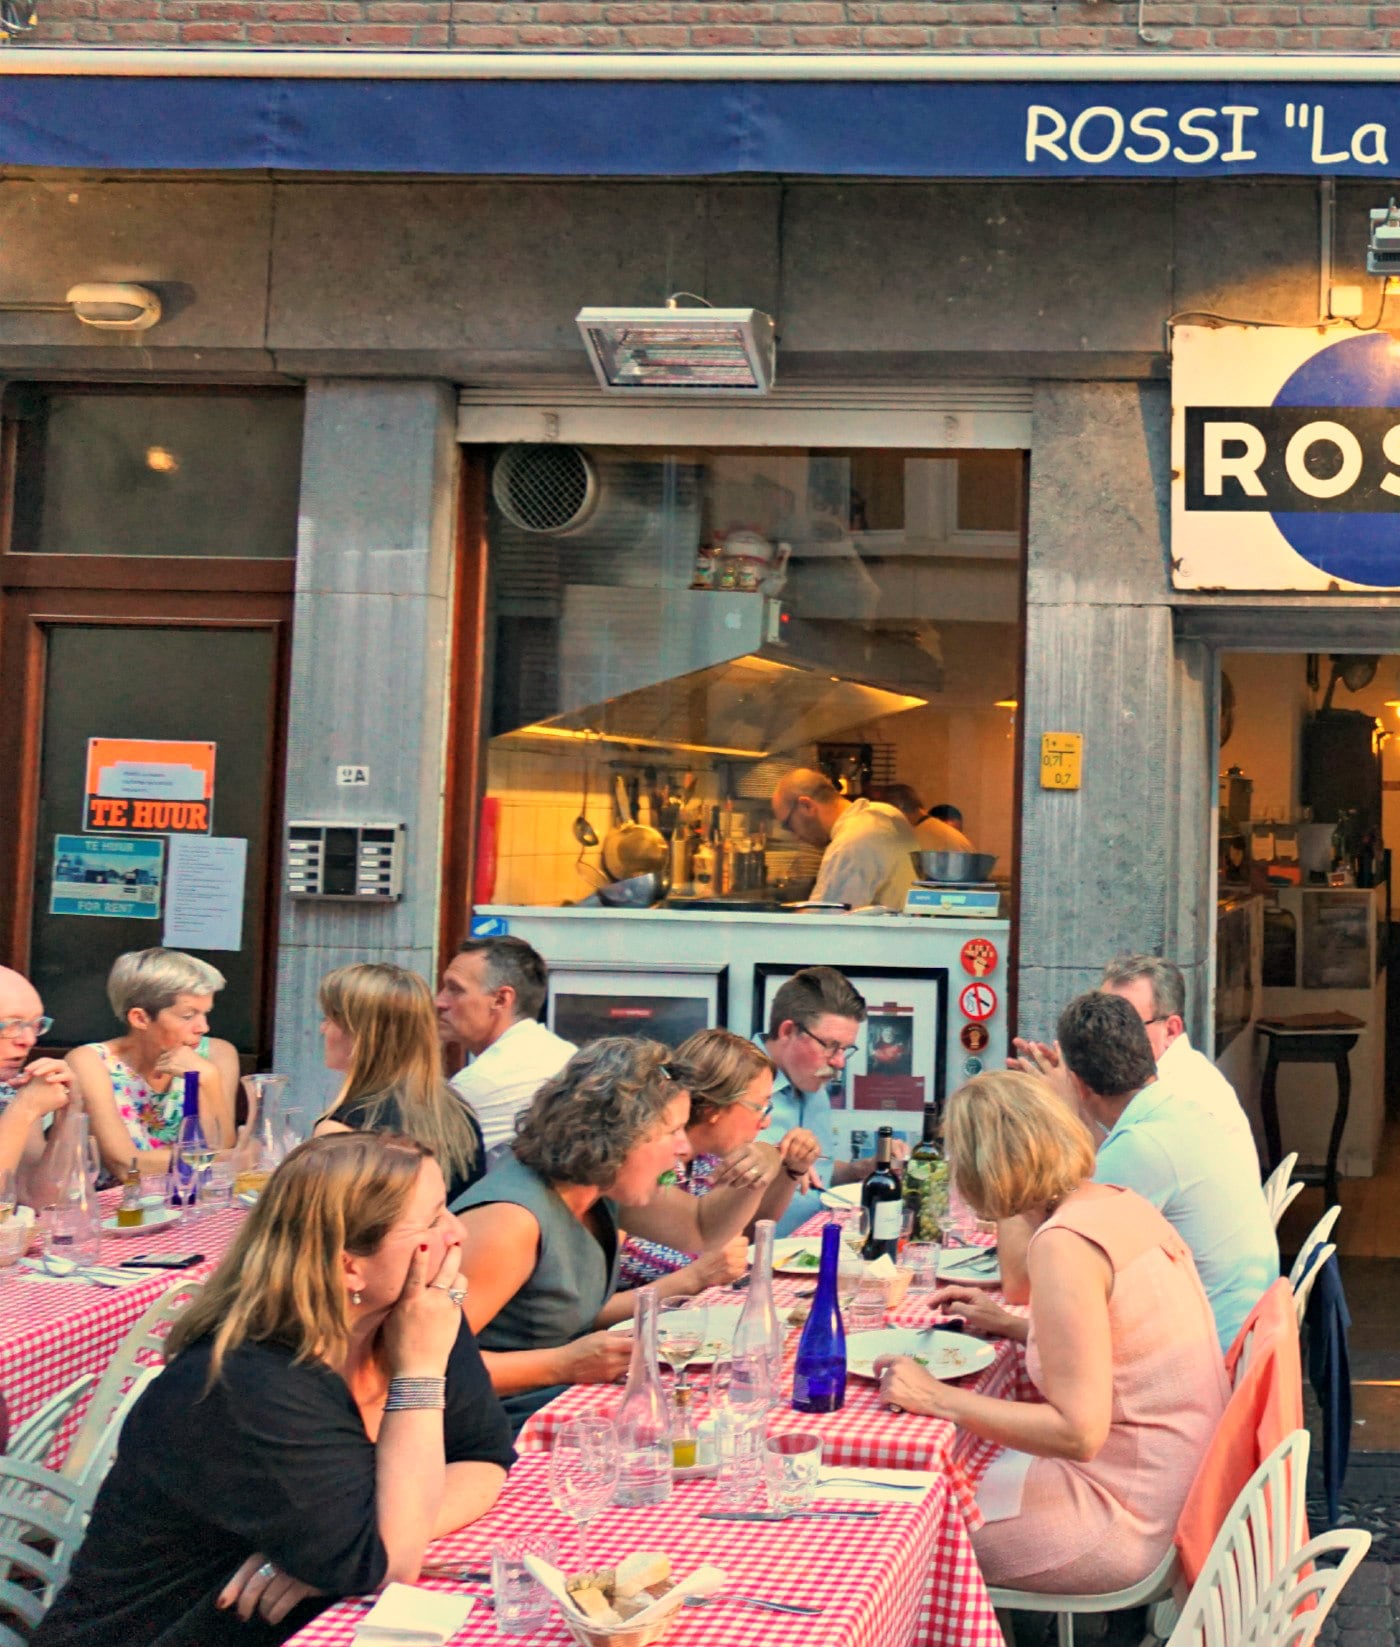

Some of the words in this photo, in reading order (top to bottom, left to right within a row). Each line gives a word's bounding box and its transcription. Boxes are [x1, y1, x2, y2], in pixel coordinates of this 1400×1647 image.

[1025, 104, 1260, 164] ROSSI
[1285, 103, 1389, 165] "La
[90, 799, 129, 827] TE
[131, 800, 208, 831] HUUR
